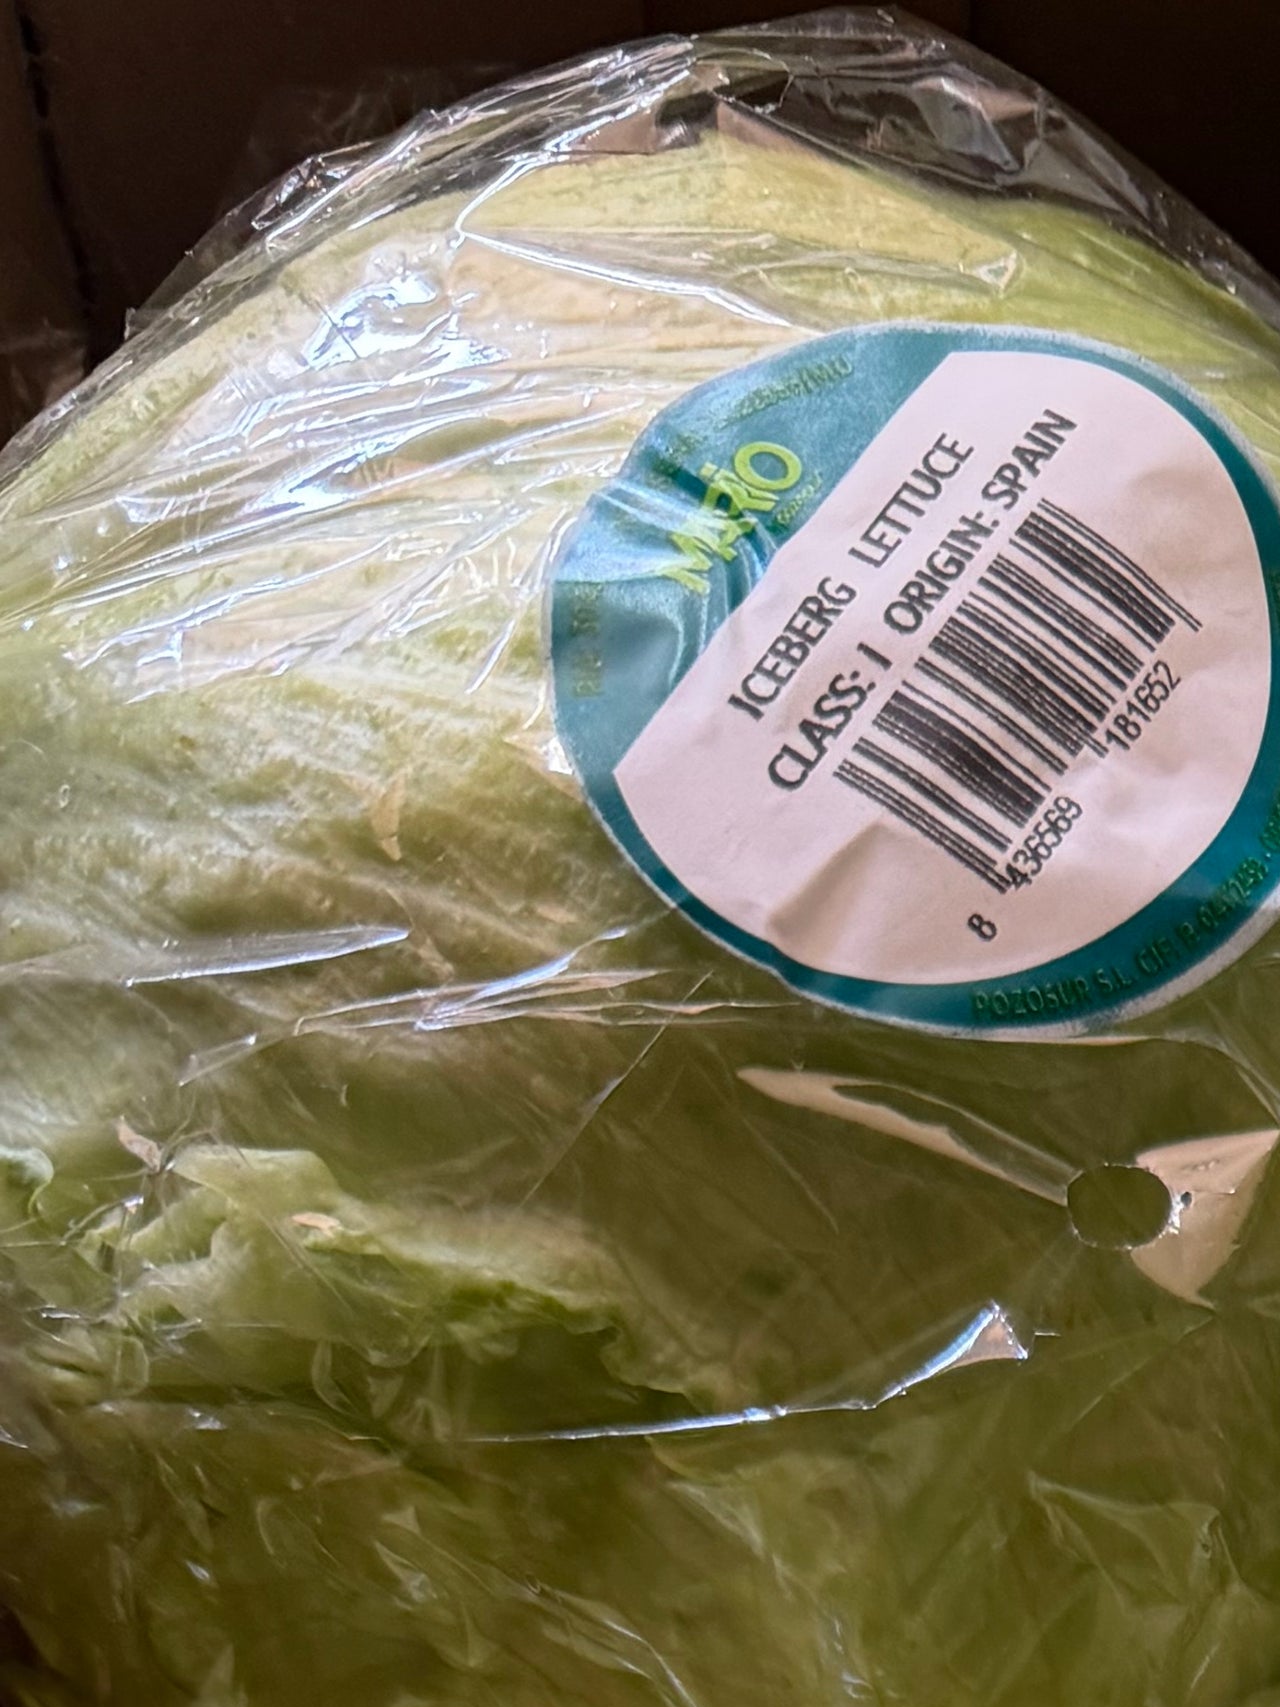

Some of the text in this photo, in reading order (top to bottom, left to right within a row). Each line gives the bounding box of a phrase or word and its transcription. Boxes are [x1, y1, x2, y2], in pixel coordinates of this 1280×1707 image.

[727, 577, 855, 721] ICEBERG
[848, 432, 973, 567] LETTUCE
[768, 409, 1076, 790] CLASS: I ORIGIN: SPAIN
[967, 659, 1180, 941] 8 436569 181652
